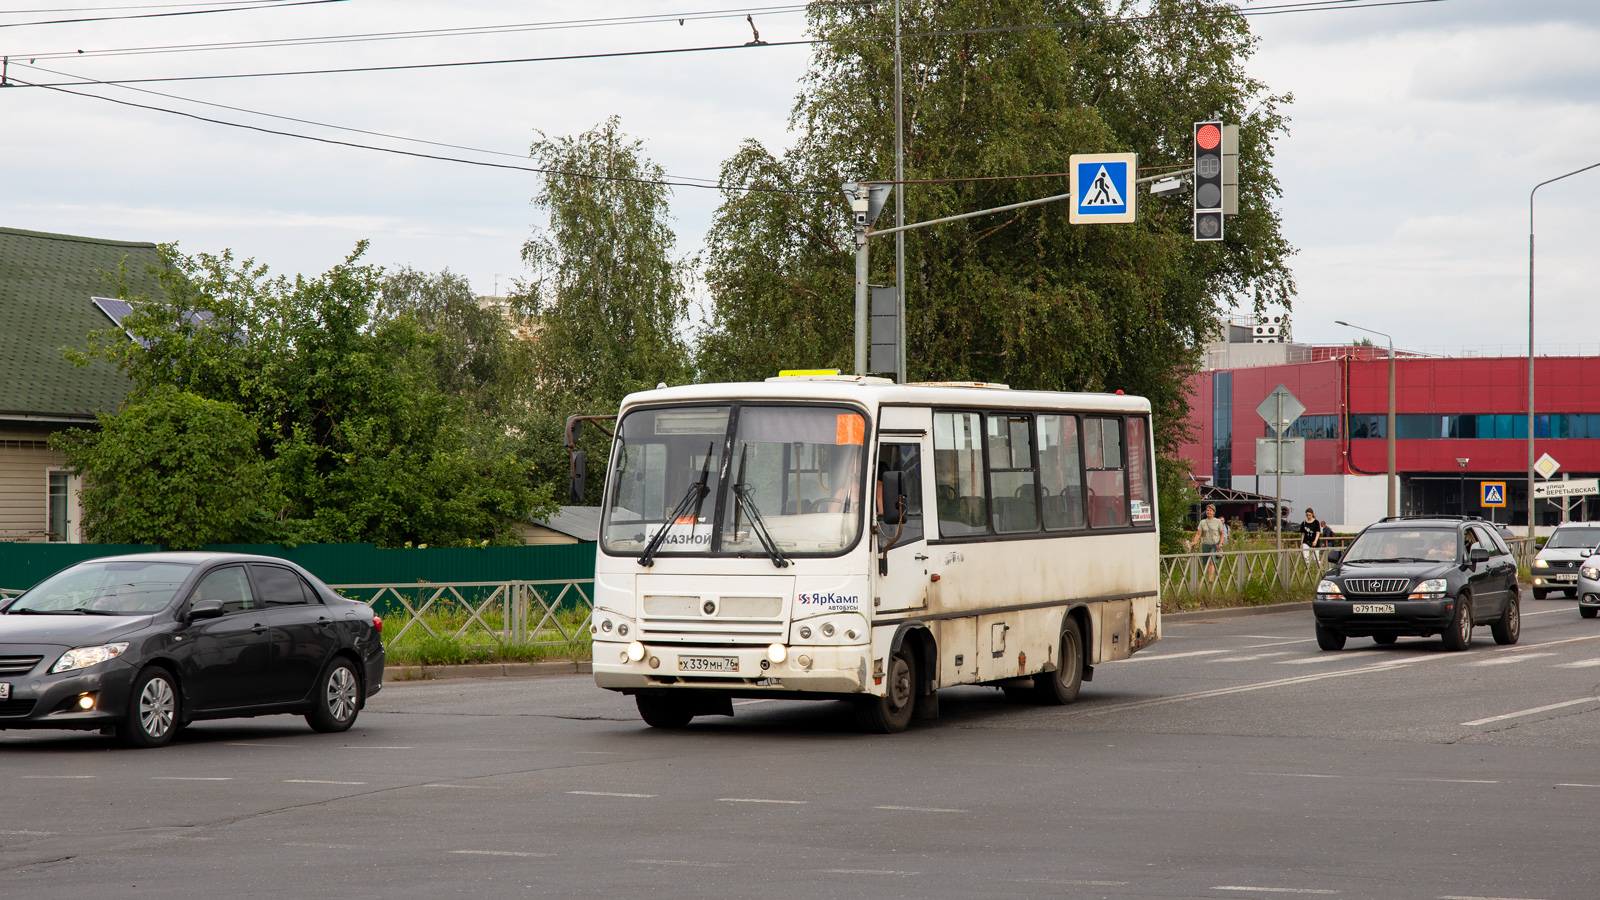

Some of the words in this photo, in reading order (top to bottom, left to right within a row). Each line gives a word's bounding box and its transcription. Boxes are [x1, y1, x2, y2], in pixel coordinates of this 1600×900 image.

[1547, 487, 1597, 496] ВЕРЕТЬЕВСКАЯ
[648, 533, 712, 545] ЗКАЗНОЙ
[812, 593, 859, 606] ЯрКамп
